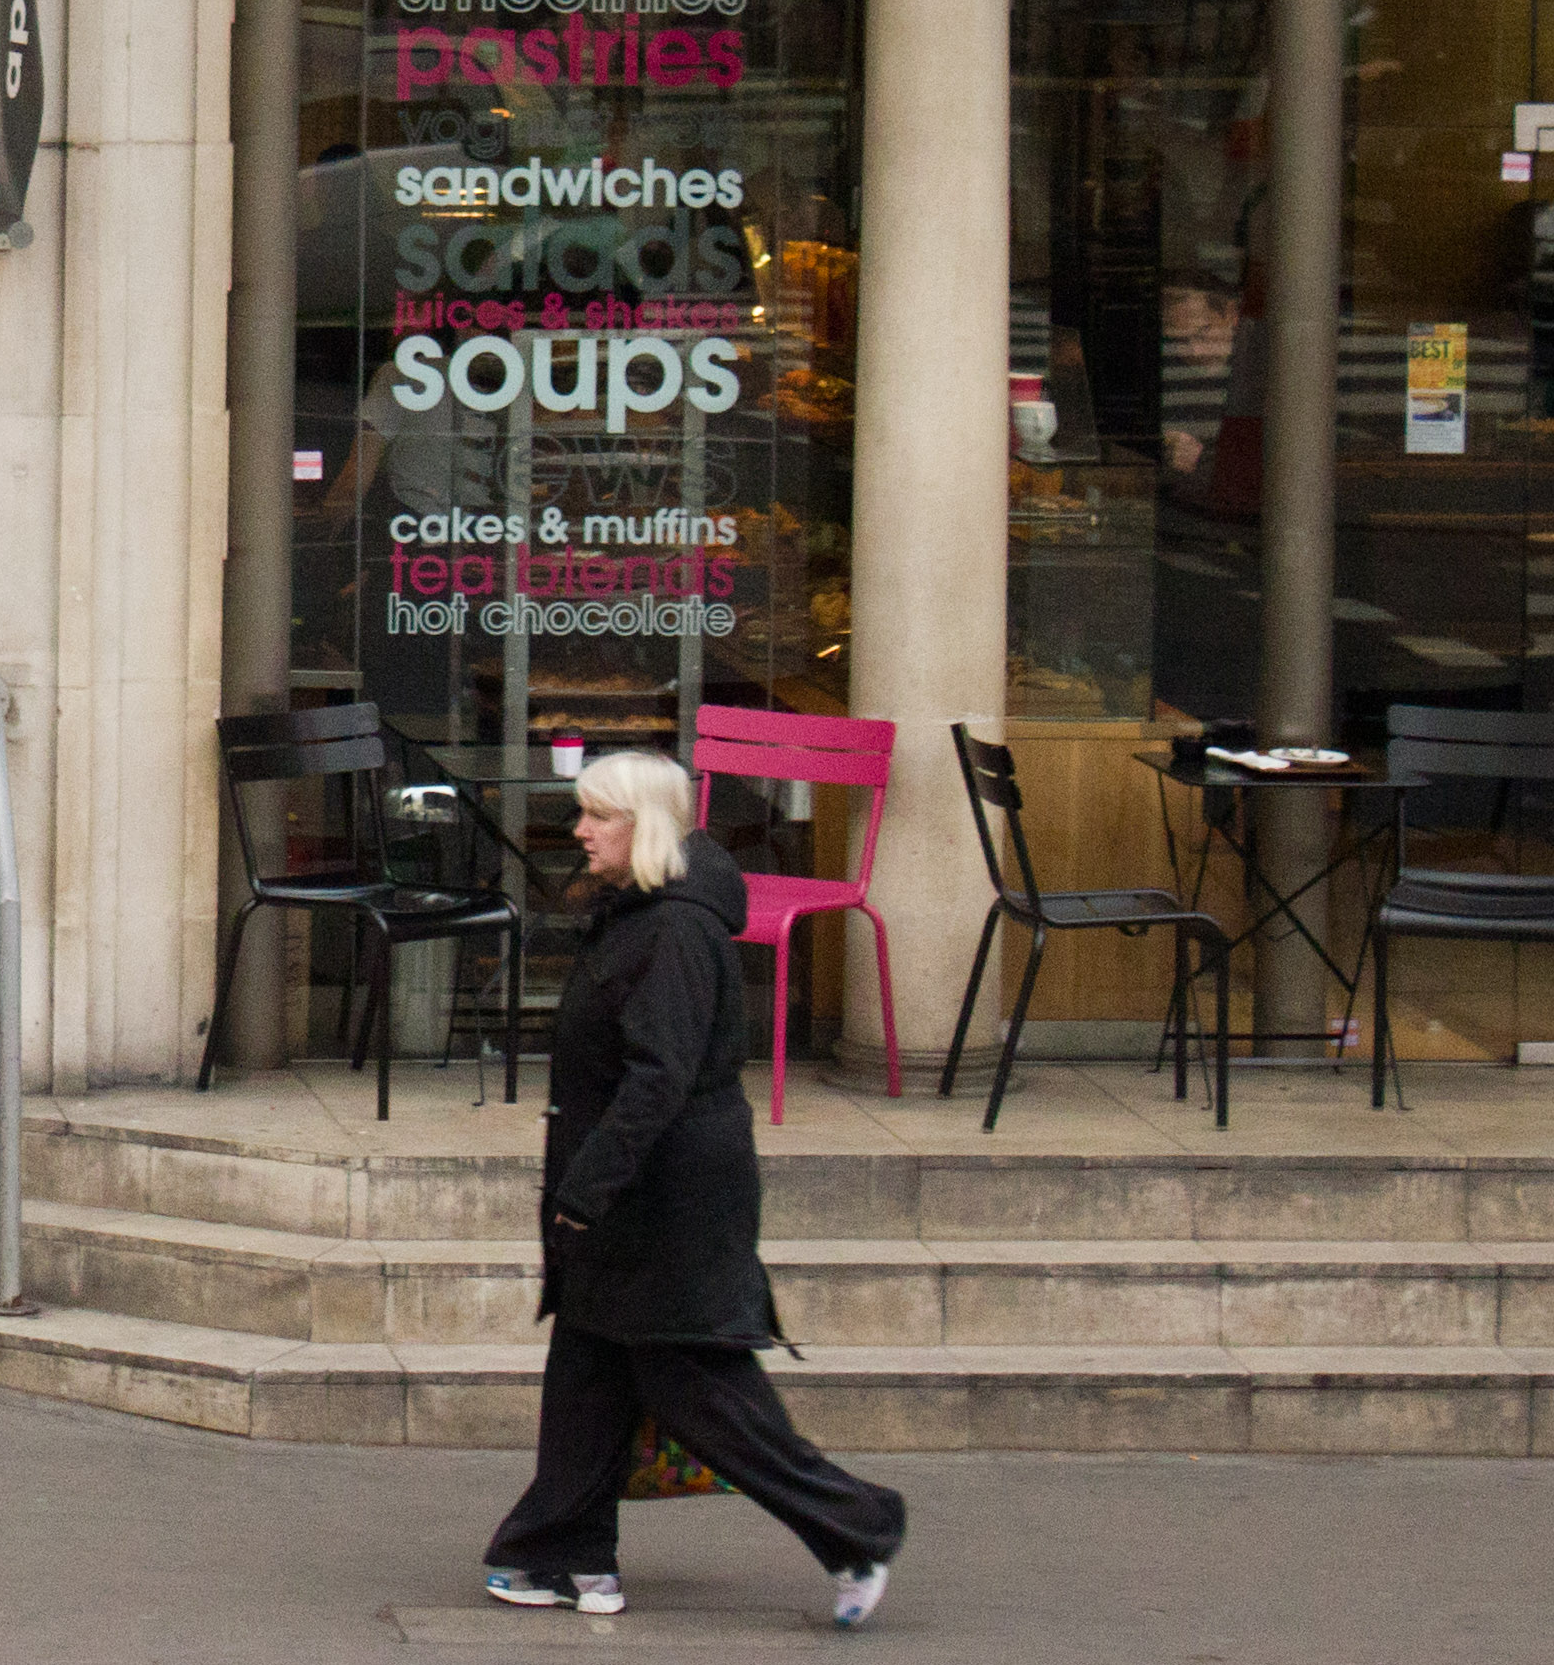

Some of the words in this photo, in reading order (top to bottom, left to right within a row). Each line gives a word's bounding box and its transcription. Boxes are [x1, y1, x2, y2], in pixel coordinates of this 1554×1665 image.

[396, 13, 745, 101] pastries
[395, 157, 744, 209] sandwiches
[394, 207, 742, 292] salads
[394, 291, 527, 336] juices
[541, 292, 570, 330] &
[585, 291, 740, 331] shakes
[393, 334, 740, 434] soups
[390, 507, 526, 544] cakes
[539, 506, 569, 544] &
[583, 507, 738, 546] muffins
[390, 543, 495, 595] tea
[516, 543, 735, 597] blends
[388, 592, 469, 635] hot
[480, 593, 737, 636] chocolate
